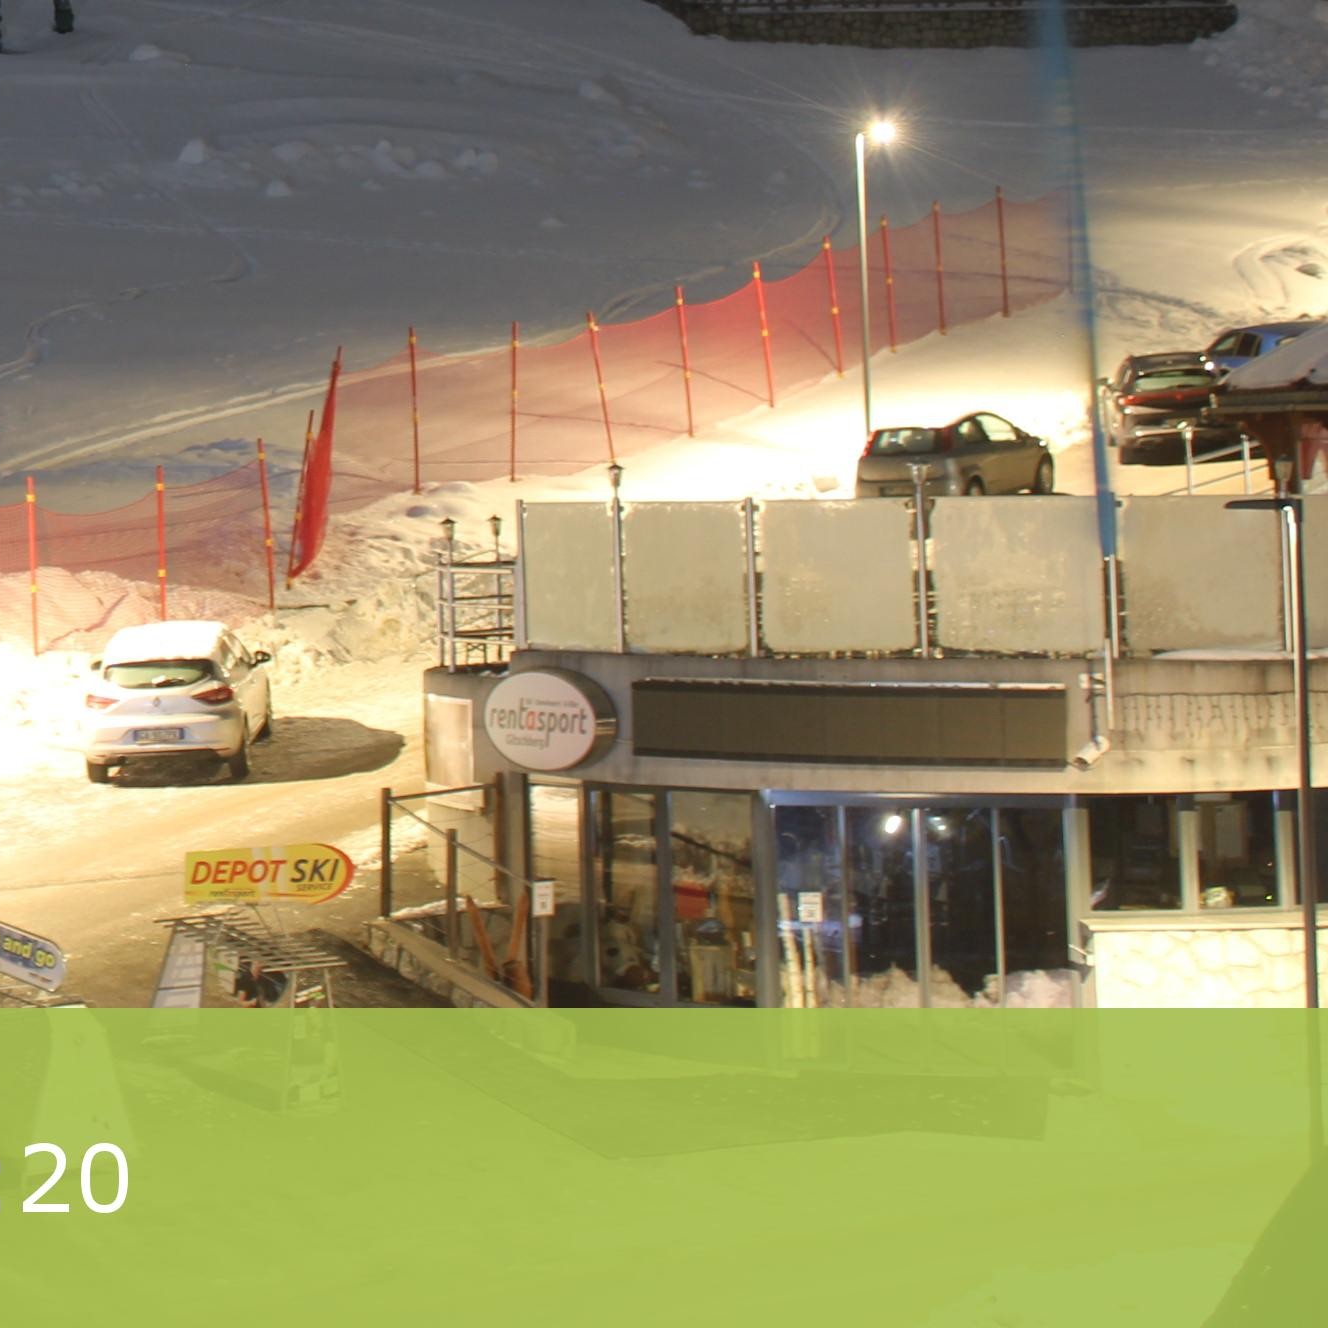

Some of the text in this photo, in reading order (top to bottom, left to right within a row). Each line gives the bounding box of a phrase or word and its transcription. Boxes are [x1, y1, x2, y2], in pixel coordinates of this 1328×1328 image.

[191, 858, 340, 885] DEPOT SKI
[297, 882, 334, 892] SERVICE
[3, 935, 32, 958] and
[35, 949, 56, 968] go
